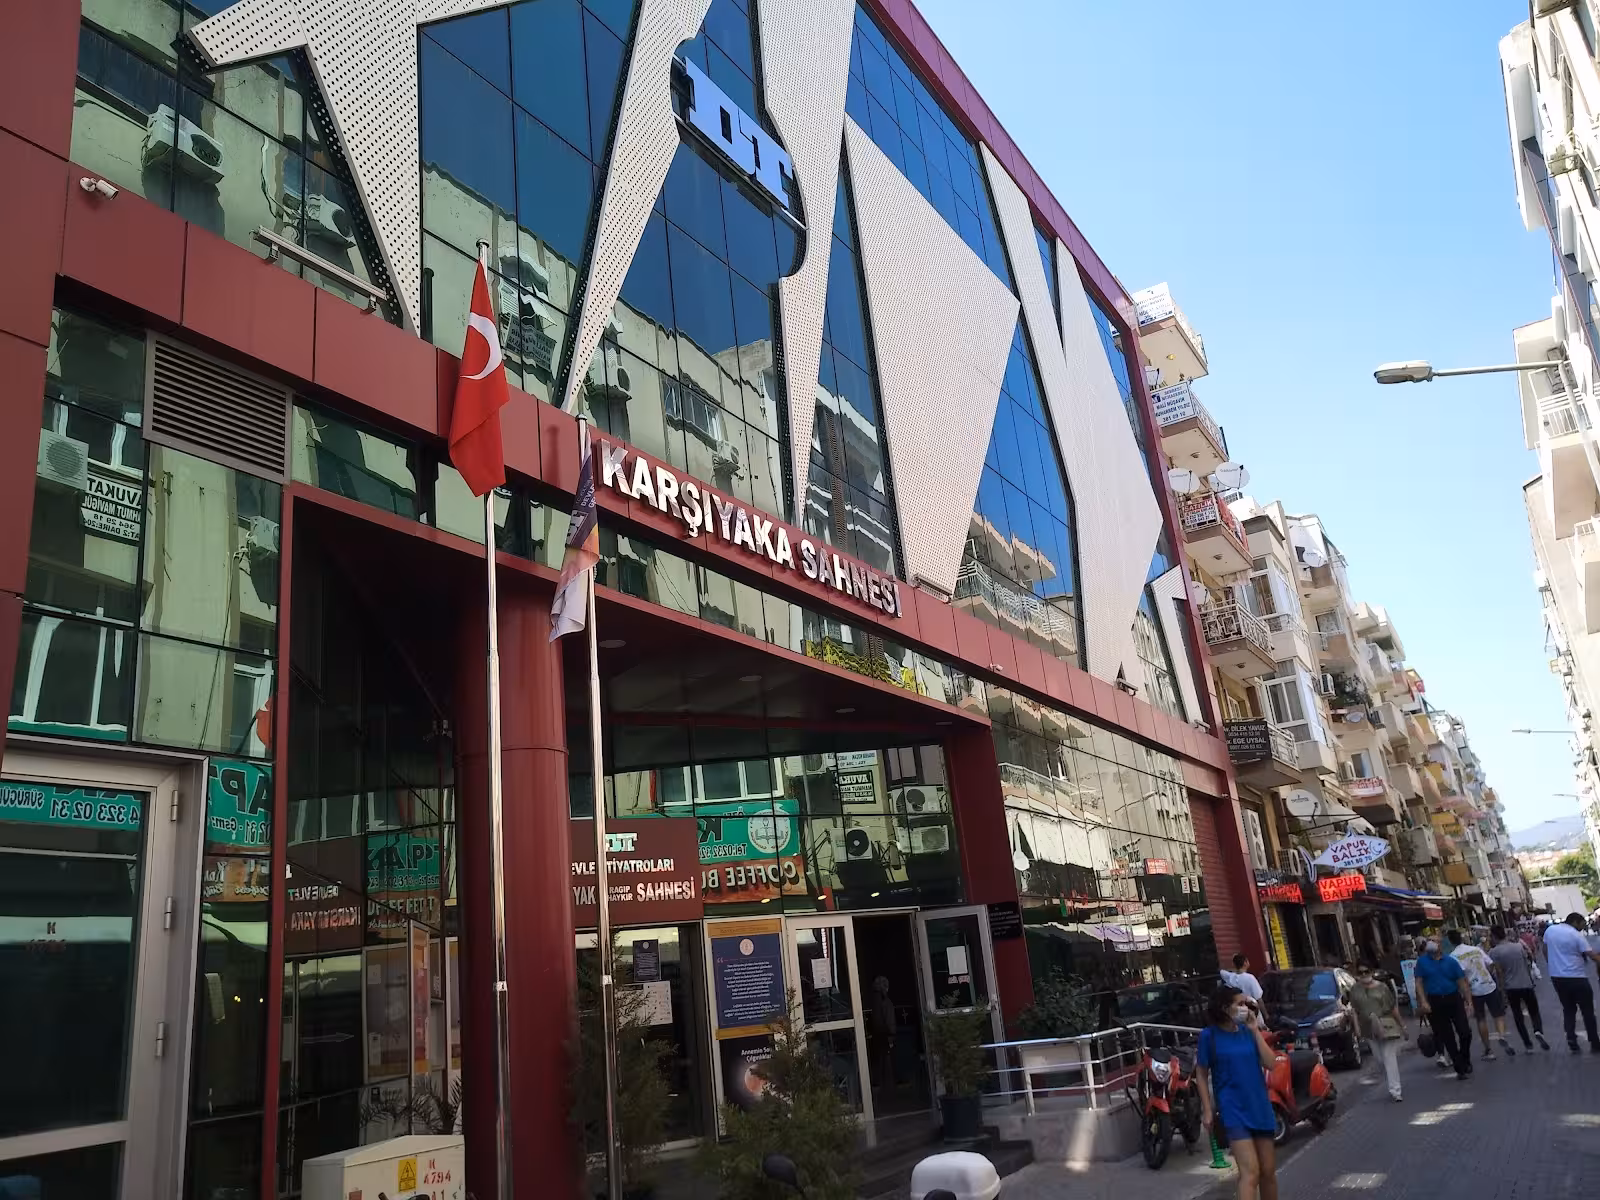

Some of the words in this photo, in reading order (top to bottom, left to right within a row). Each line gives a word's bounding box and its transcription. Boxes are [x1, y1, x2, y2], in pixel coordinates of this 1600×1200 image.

[600, 438, 797, 539] KARŞIYAKA
[1330, 840, 1367, 854] VAPUR
[1331, 846, 1371, 863] BALIK
[606, 857, 675, 874] TİYATROLARI
[636, 876, 697, 902] SAHNESİ
[1320, 876, 1364, 891] VAPUR
